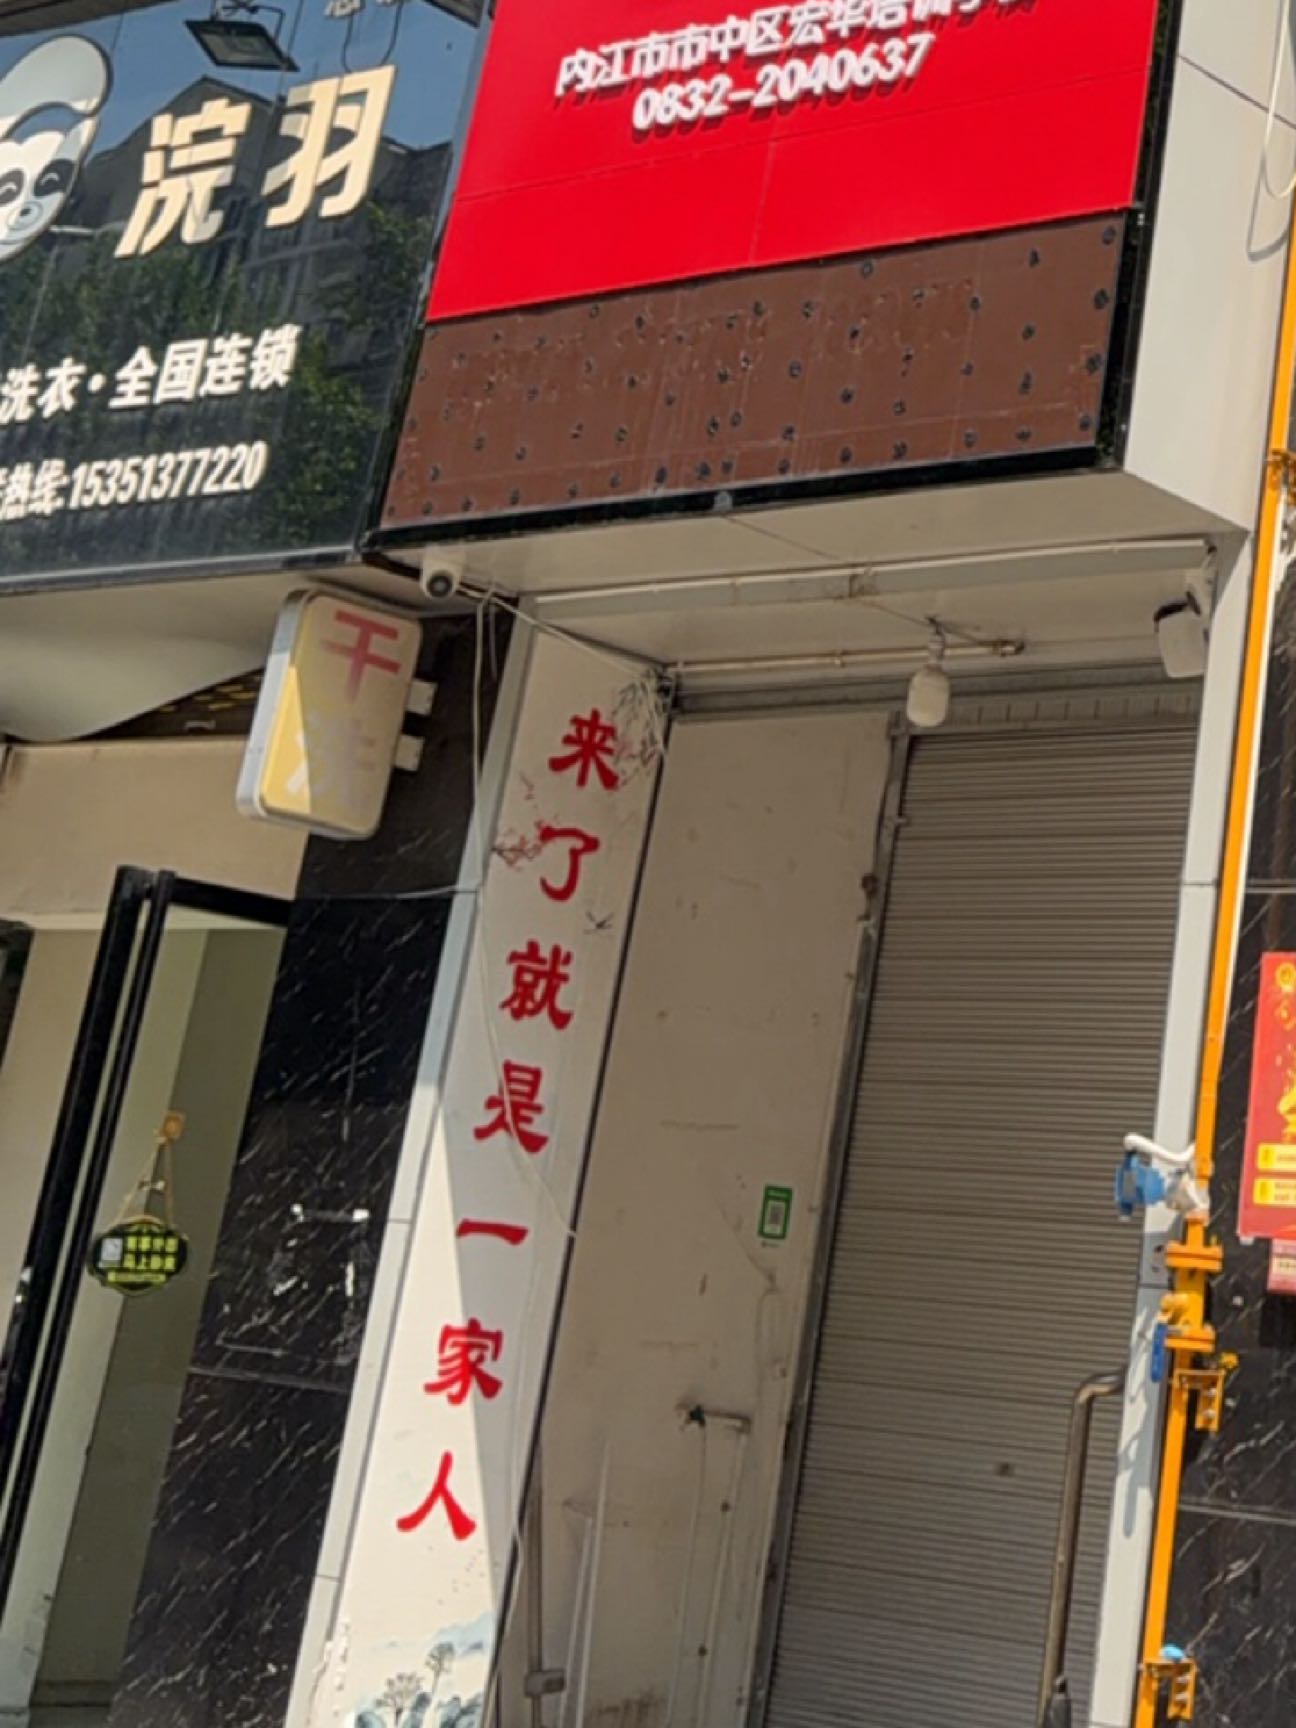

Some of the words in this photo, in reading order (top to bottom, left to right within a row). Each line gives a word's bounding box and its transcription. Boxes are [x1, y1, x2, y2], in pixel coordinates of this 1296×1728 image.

[633, 34, 935, 130] 0832-2040637
[396, 709, 619, 1541] 来了就是一家人
